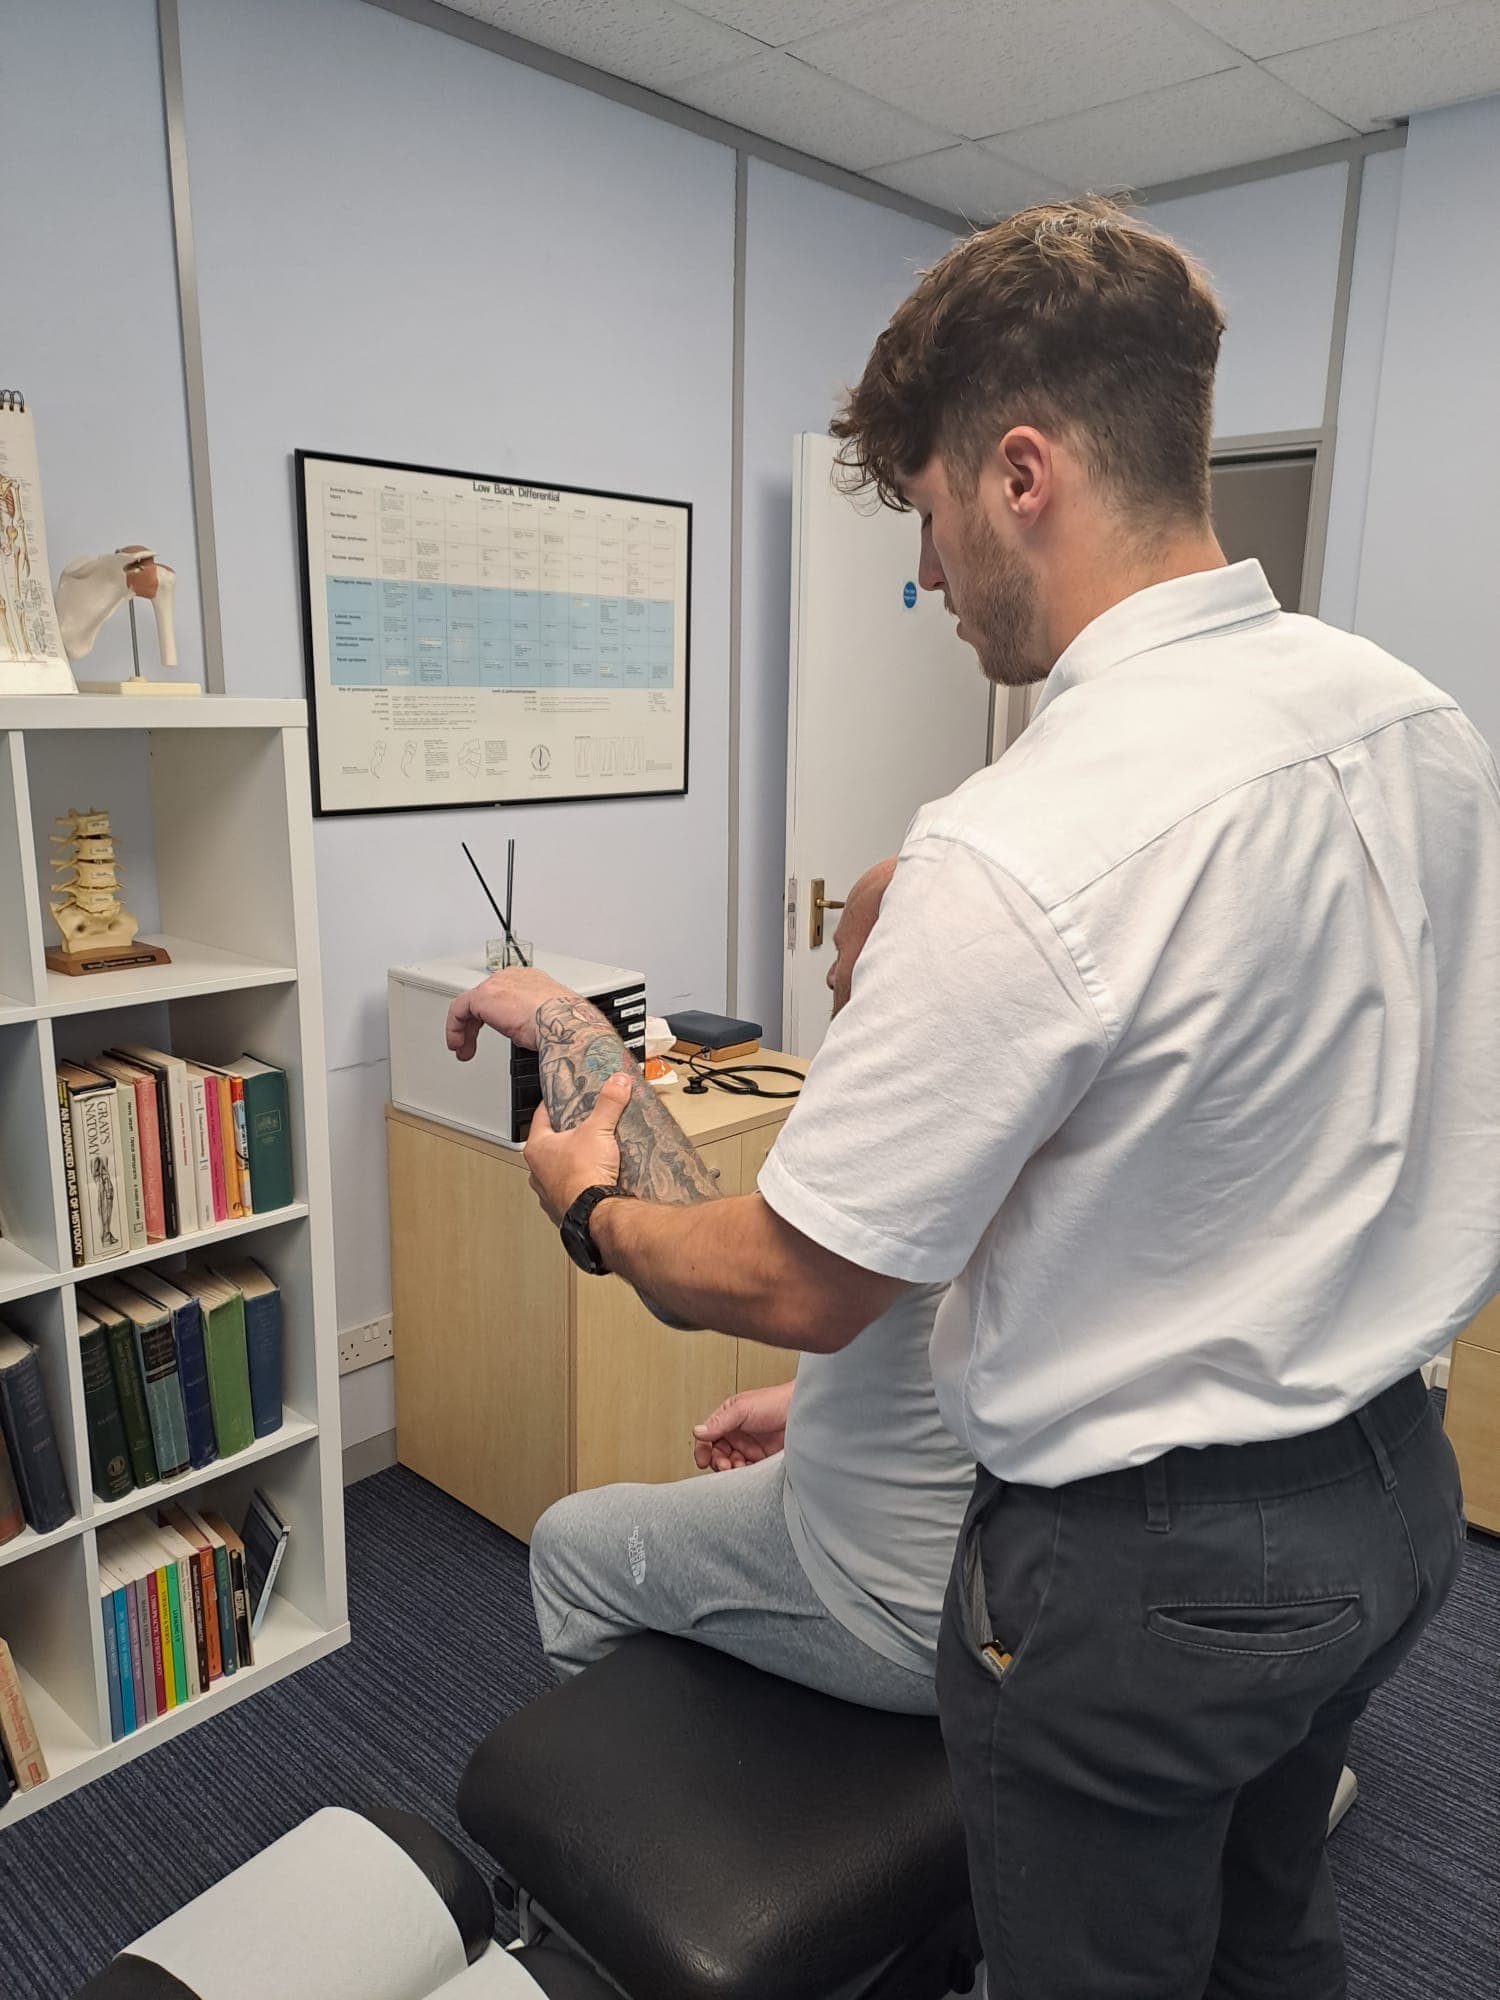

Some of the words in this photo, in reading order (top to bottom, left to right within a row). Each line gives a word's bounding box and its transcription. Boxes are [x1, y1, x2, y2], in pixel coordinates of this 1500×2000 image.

[473, 481, 490, 493] Low
[494, 483, 514, 496] Back
[518, 487, 560, 502] Differential
[61, 1108, 70, 1121] AN
[84, 1101, 100, 1156] NATOMY
[97, 1101, 111, 1145] GRAY'S
[62, 1122, 74, 1168] ADVANCED
[66, 1169, 77, 1197] ATLAS
[70, 1197, 79, 1209] OF
[71, 1209, 83, 1255] HISTOLOGY
